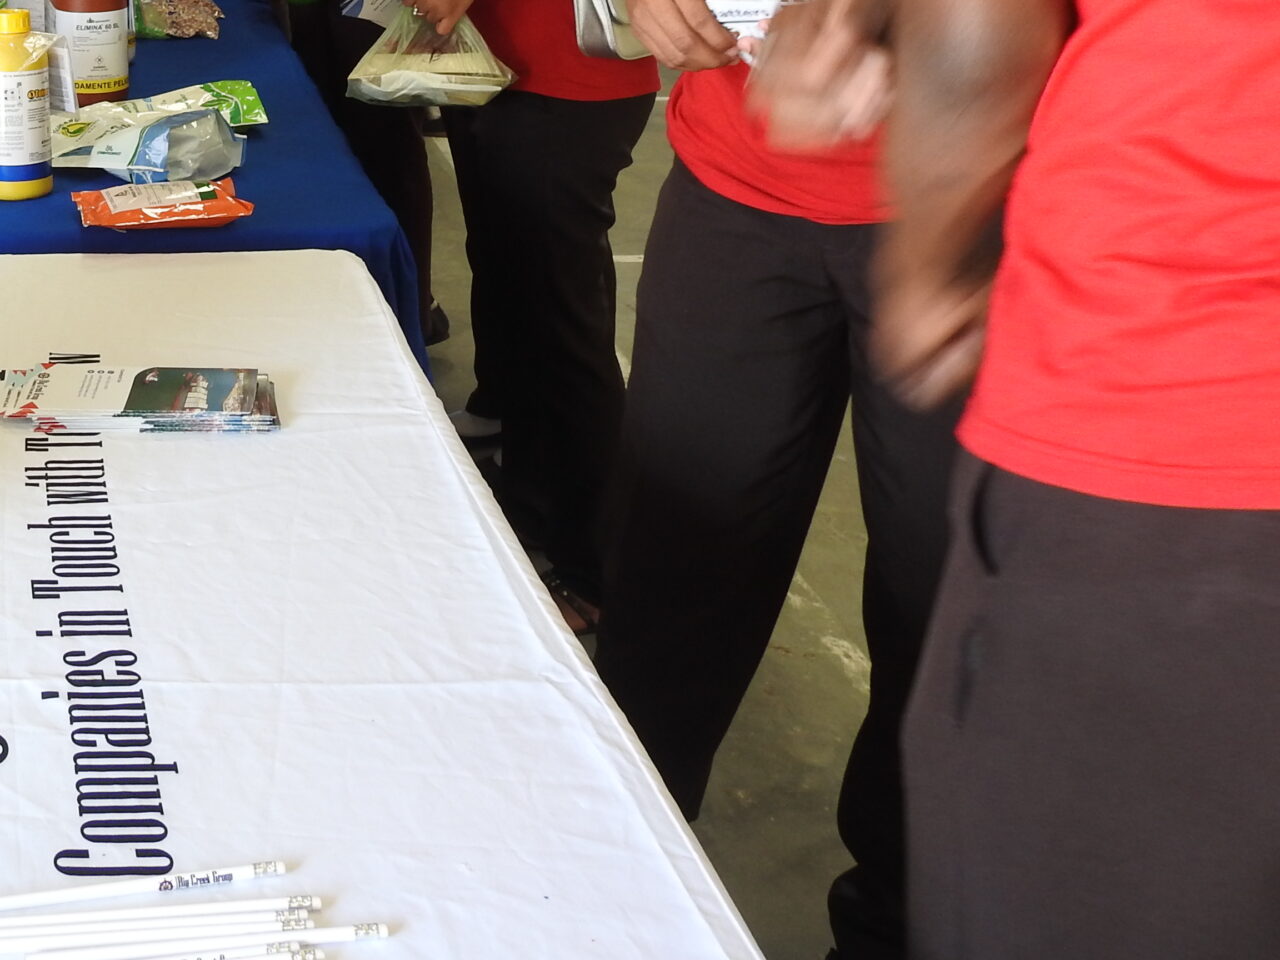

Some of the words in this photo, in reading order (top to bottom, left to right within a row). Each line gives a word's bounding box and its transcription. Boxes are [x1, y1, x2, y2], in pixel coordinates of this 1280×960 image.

[74, 81, 112, 90] DAMENTE
[24, 458, 109, 507] with
[27, 514, 124, 599] Touch
[35, 608, 133, 637] in
[41, 649, 179, 877] Companies
[190, 873, 211, 886] Creek
[212, 870, 234, 884] Group
